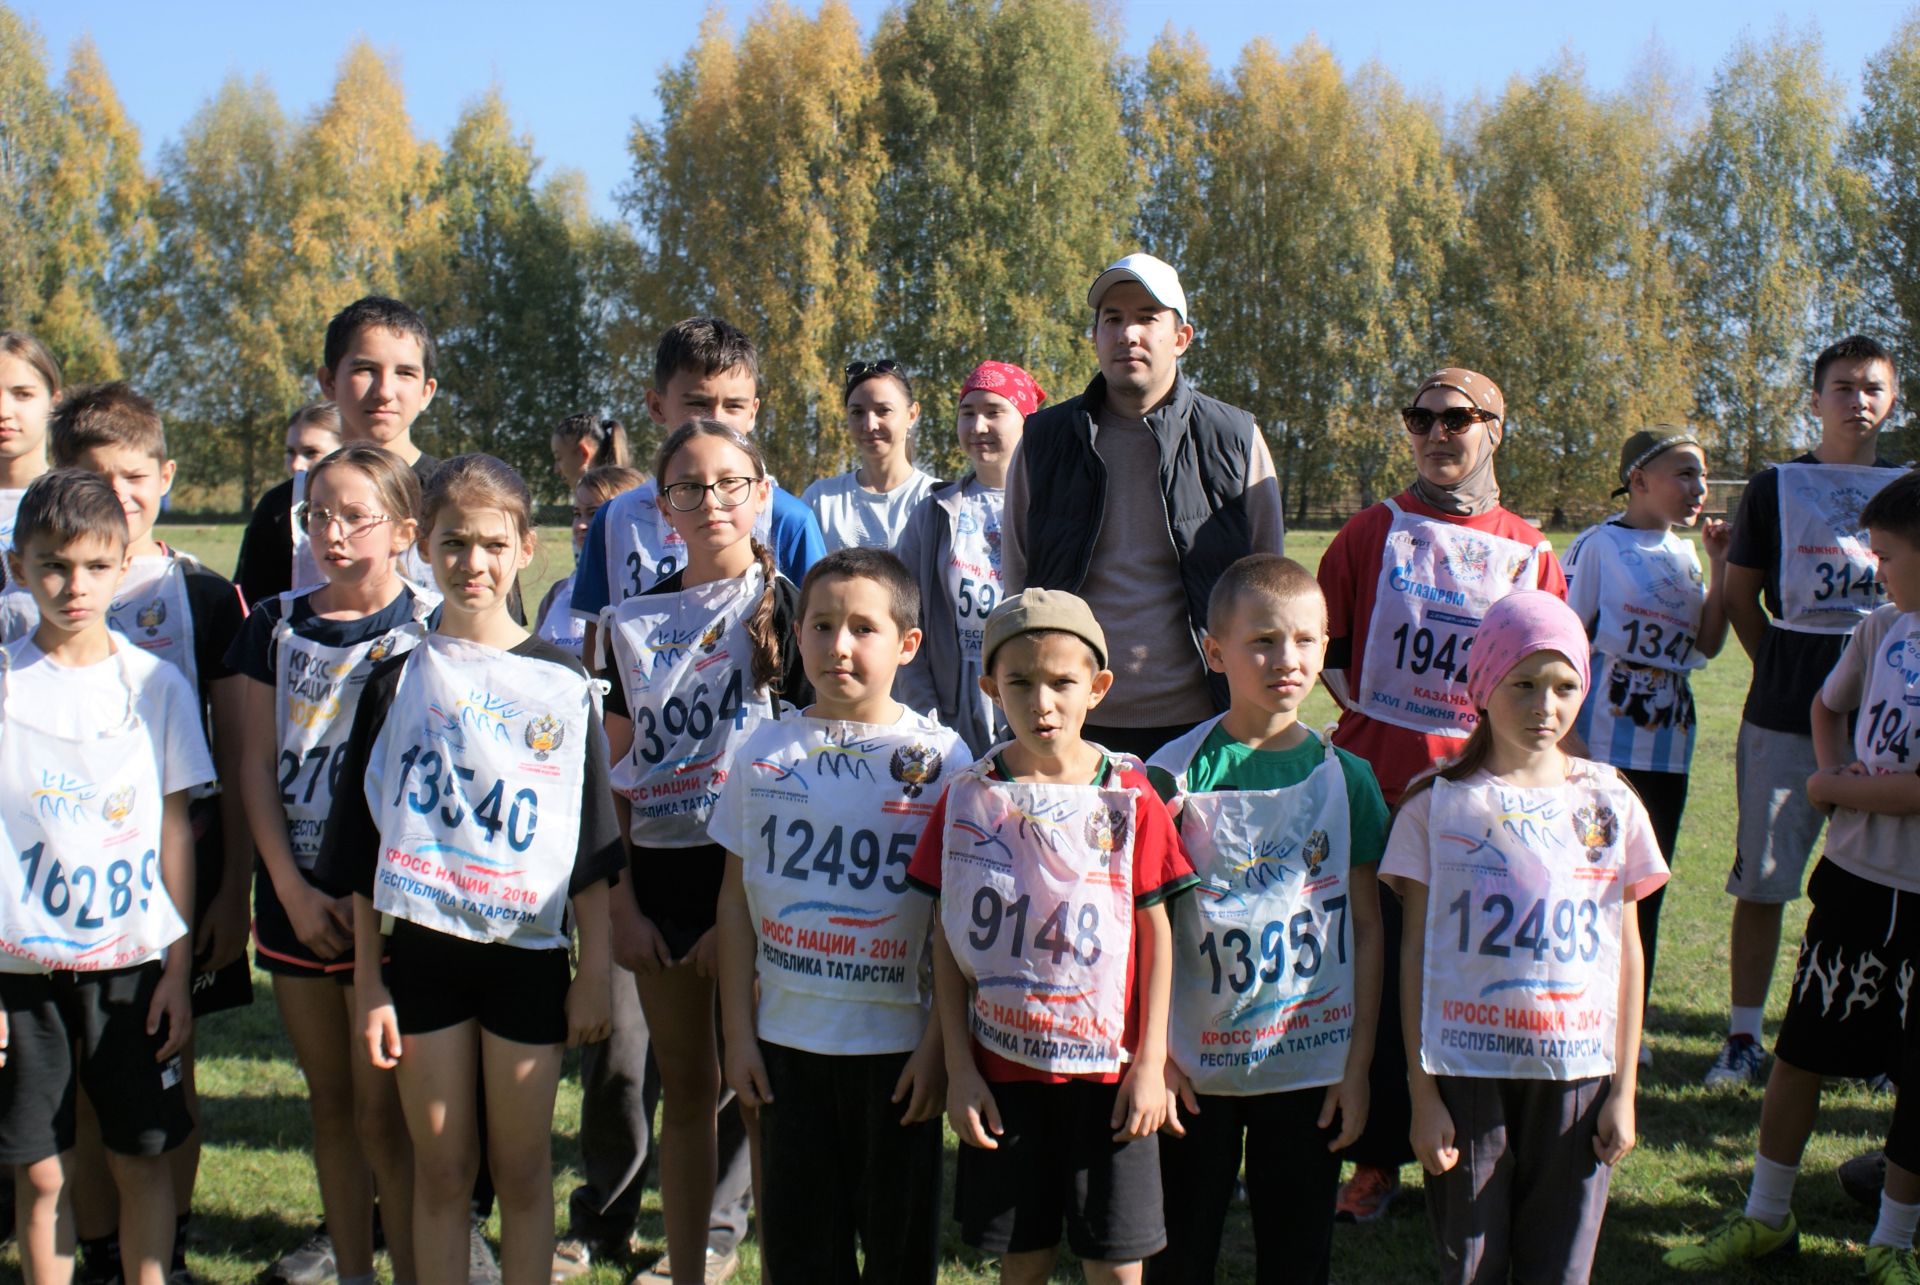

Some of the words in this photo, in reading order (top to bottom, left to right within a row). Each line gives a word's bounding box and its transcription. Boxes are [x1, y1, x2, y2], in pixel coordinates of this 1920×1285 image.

[959, 577, 995, 619] 59
[1409, 581, 1465, 608] ГАЗПРОМ
[1405, 701, 1456, 720] ЛЫЖНЯ
[1413, 687, 1468, 705] КАЗАНЬ
[632, 669, 748, 766] 3964
[1867, 699, 1920, 763] 194
[393, 744, 538, 852] 13540
[652, 777, 701, 798] НАЦИИ
[760, 814, 918, 895] 12495
[379, 868, 457, 907] РЕСПУБЛИКА
[461, 898, 537, 924] ТАТАРСТАН
[385, 847, 432, 875] КРОСС
[436, 865, 490, 896] НАЦИИ
[502, 886, 538, 905] 2018
[761, 916, 793, 946] КРОСС
[796, 928, 857, 957] НАЦИИ
[869, 938, 907, 960] 2014
[968, 886, 1101, 967] 9148
[1200, 894, 1348, 994] 13957
[1449, 890, 1601, 963] 12493
[762, 941, 823, 977] РЕСПУБЛИКА
[826, 960, 906, 983] ТАТАРСТАН
[993, 1003, 1055, 1035] НАЦИИ
[1068, 1014, 1108, 1038] 2014
[1202, 1030, 1252, 1046] КРОСС
[1256, 1014, 1310, 1041] НАЦИИ
[1442, 999, 1500, 1026] КРОСС
[1505, 1008, 1566, 1035] НАЦИИ
[1023, 1038, 1106, 1060] ТАТАРСТАН
[1200, 1044, 1285, 1068] РЕСПУБЛИКА
[1441, 1028, 1535, 1057] РЕСПУБЛИКА
[1539, 1038, 1602, 1059] ТАТАРСТАН
